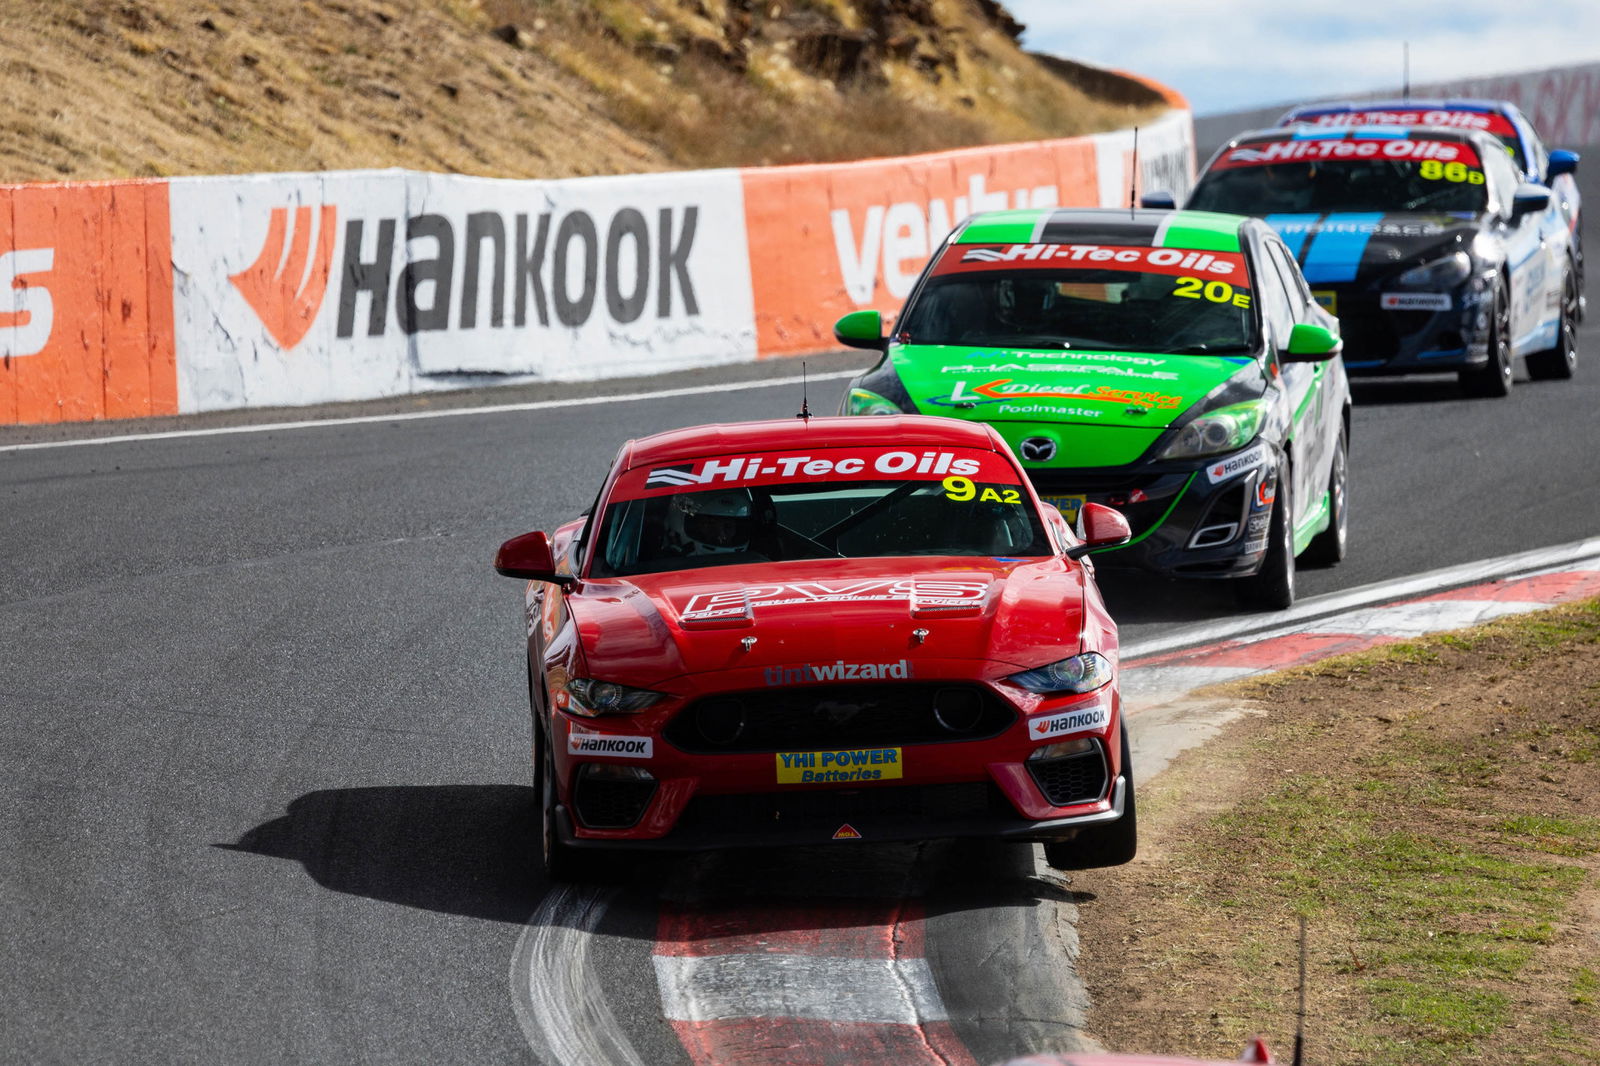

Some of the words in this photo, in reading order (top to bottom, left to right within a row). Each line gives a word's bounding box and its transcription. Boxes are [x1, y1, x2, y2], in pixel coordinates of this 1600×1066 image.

[1262, 141, 1376, 161] Hi-Tec
[1382, 138, 1460, 160] Oils
[999, 244, 1140, 264] Hi-Tec
[1146, 248, 1236, 275] Oils
[1008, 351, 1167, 366] Technology
[999, 404, 1105, 418] Poolmaster
[700, 455, 866, 483] Hi-Tec
[874, 451, 981, 475] Oils
[780, 753, 815, 768] YHI
[822, 749, 897, 767] POWER
[801, 768, 882, 783] Batteries
